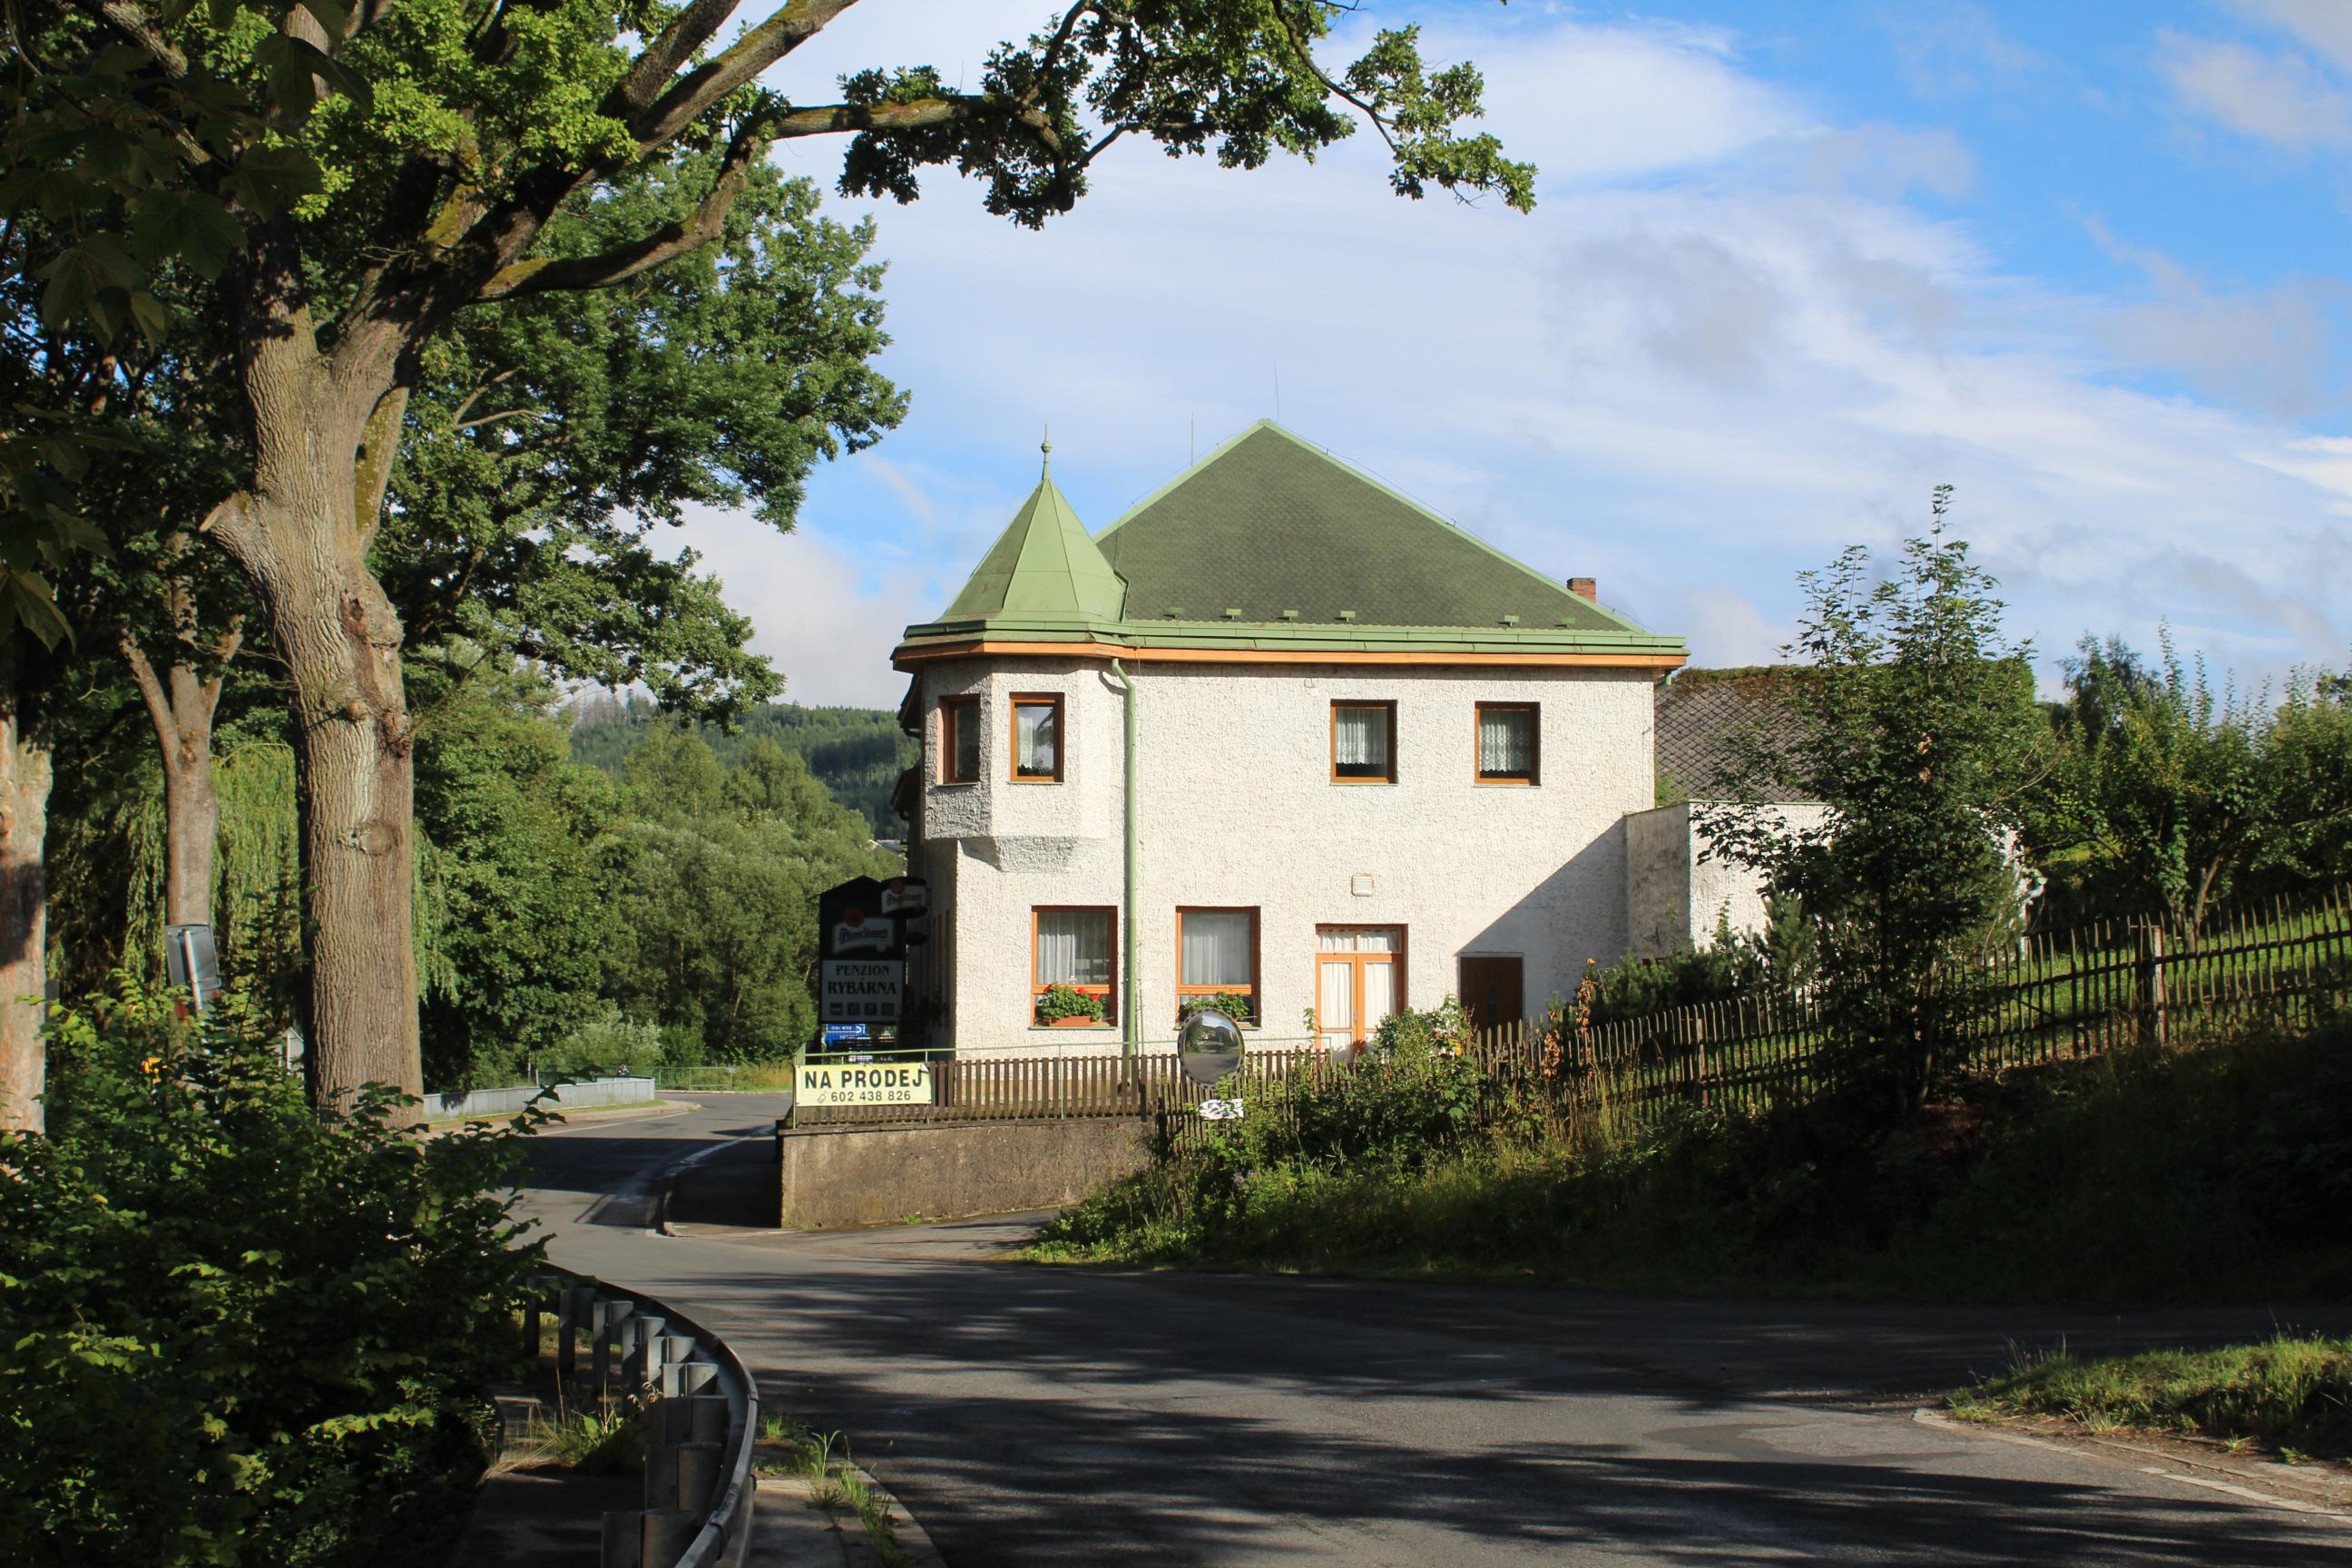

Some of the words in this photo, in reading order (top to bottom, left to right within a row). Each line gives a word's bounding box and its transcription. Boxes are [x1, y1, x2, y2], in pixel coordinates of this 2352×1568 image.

[836, 965, 889, 975] PENZION
[828, 977, 897, 995] RYBÁRNA
[805, 1072, 831, 1088] NA
[842, 1069, 922, 1088] PRODEJ
[830, 1091, 854, 1102] 602
[859, 1091, 882, 1102] 438
[887, 1090, 911, 1101] 826
